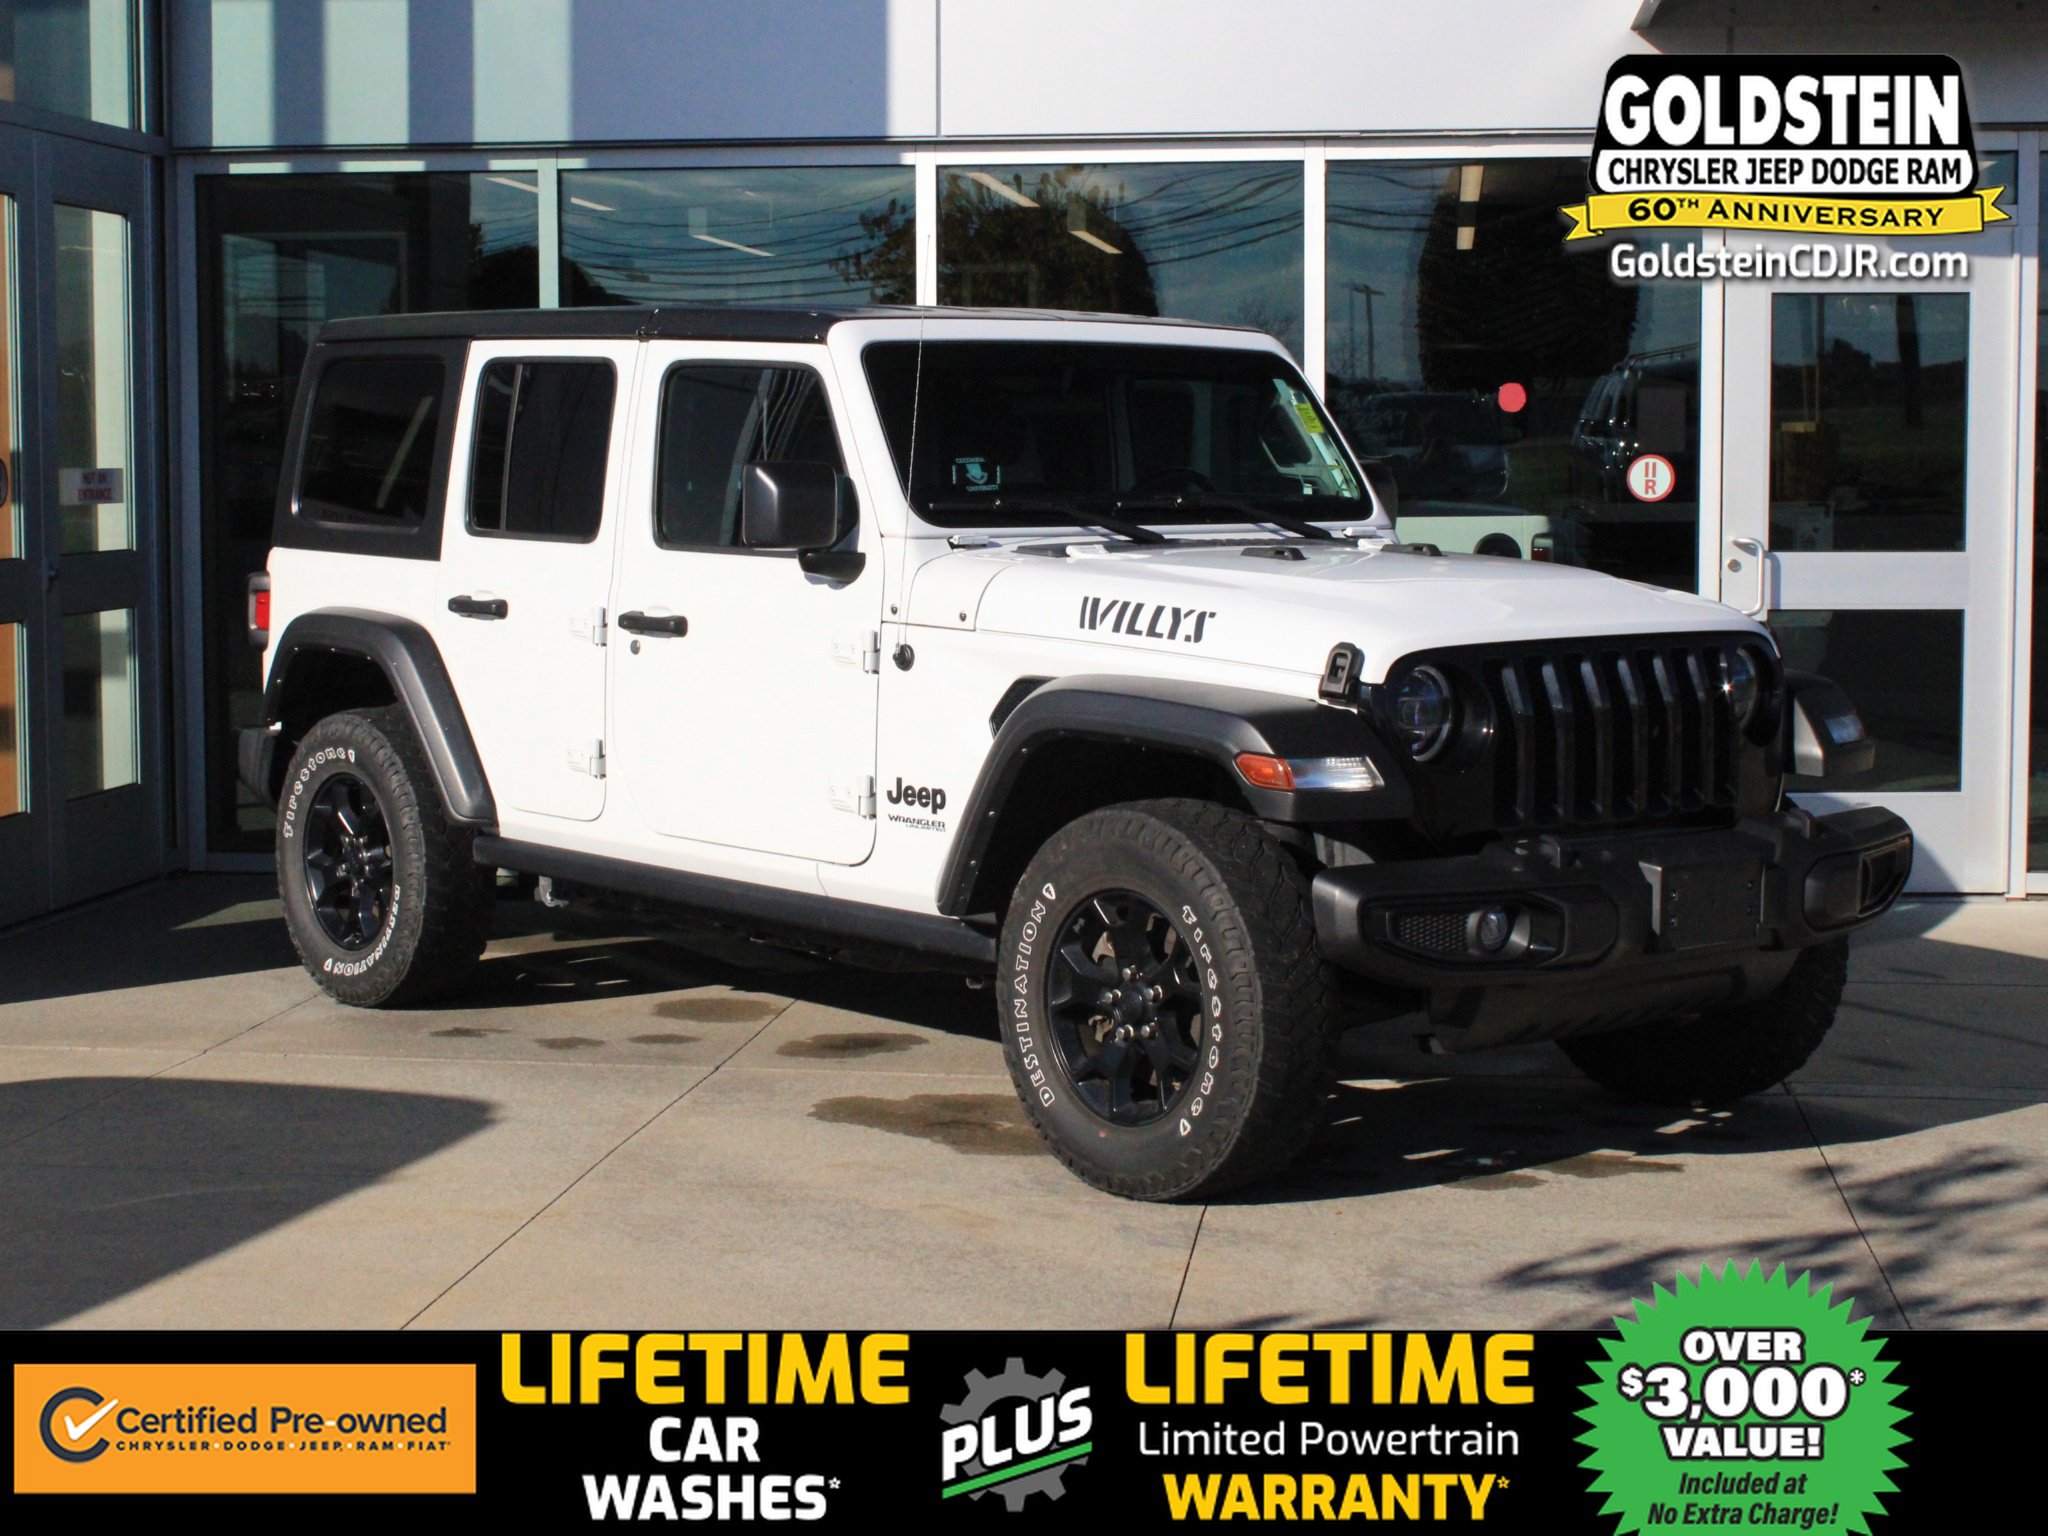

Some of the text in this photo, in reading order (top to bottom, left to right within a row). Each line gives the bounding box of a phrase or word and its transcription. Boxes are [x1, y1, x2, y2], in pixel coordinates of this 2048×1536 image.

[1079, 596, 1217, 643] WILLYS
[284, 747, 346, 838] Firestone
[887, 777, 946, 815] Jeep
[888, 813, 946, 828] WRANGLER
[1014, 901, 1055, 1107] DESTINATION
[1183, 905, 1222, 1116] Firestone
